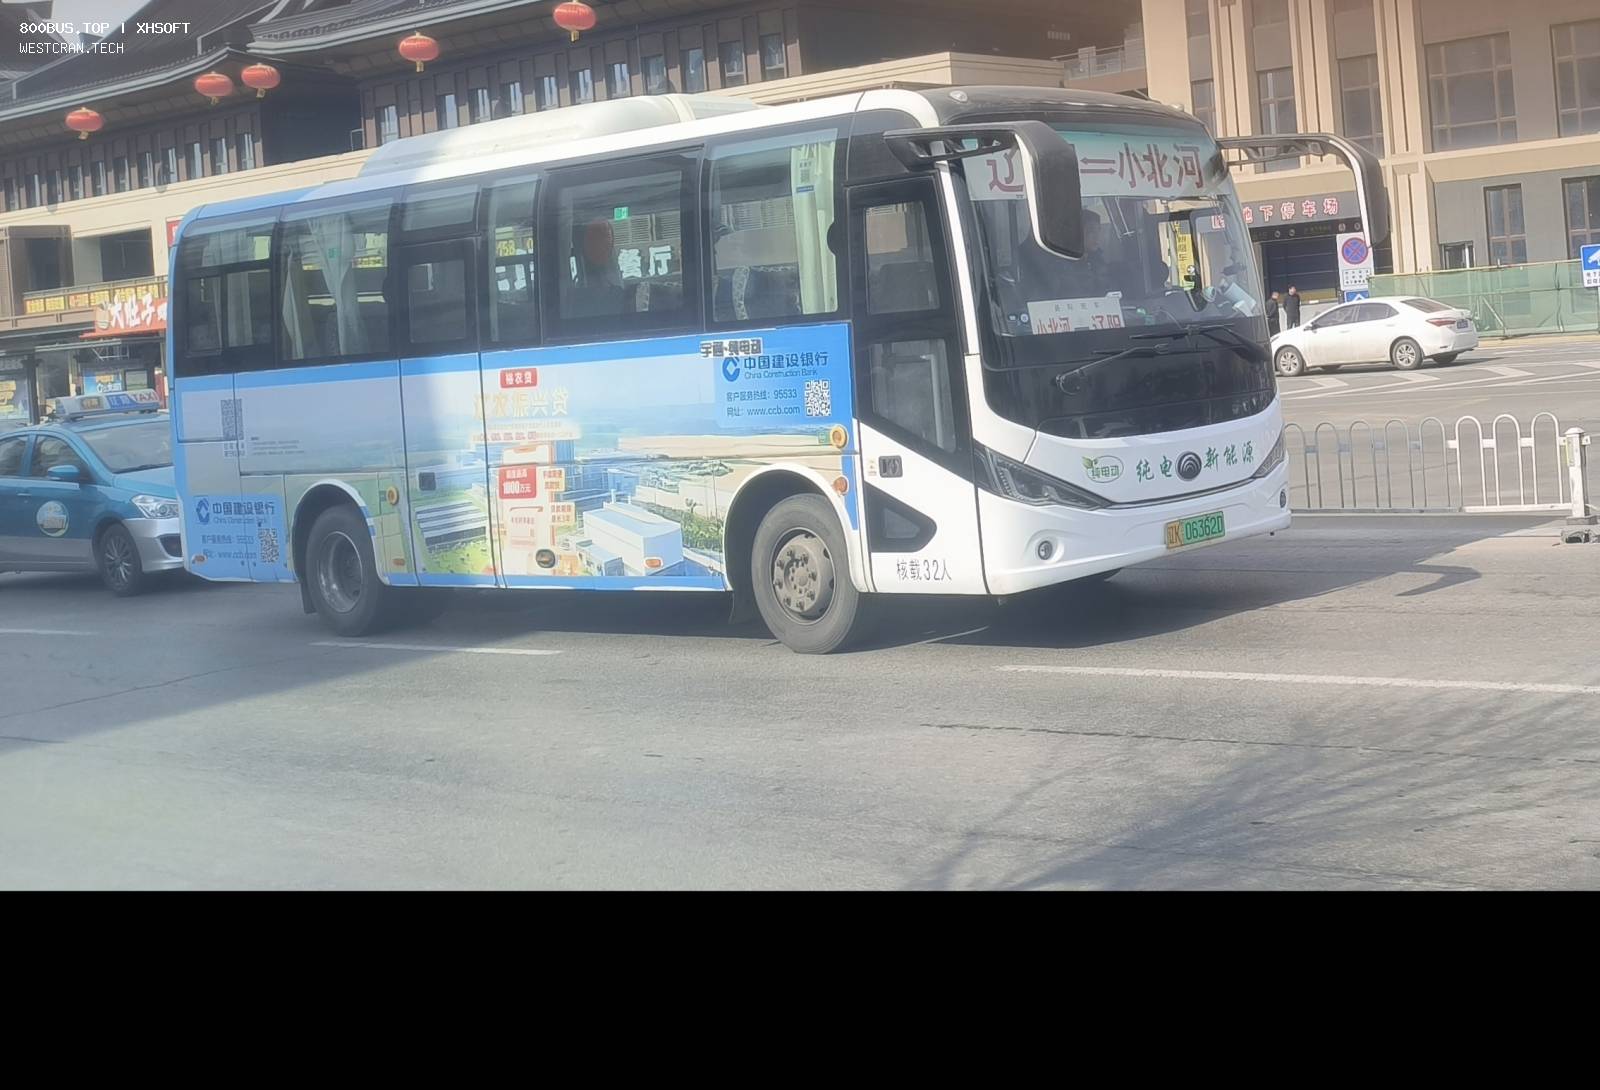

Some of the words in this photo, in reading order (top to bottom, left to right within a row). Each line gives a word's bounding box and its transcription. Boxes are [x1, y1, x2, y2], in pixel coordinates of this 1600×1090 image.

[1118, 142, 1204, 189] 小北河
[744, 351, 829, 370] 中国建设银行
[744, 370, 762, 380] China
[763, 369, 800, 379] Construction
[801, 367, 818, 377] Bank
[1203, 439, 1256, 473] 新能源
[212, 501, 275, 516] 中国建设银行
[896, 559, 953, 581] 核载32人
